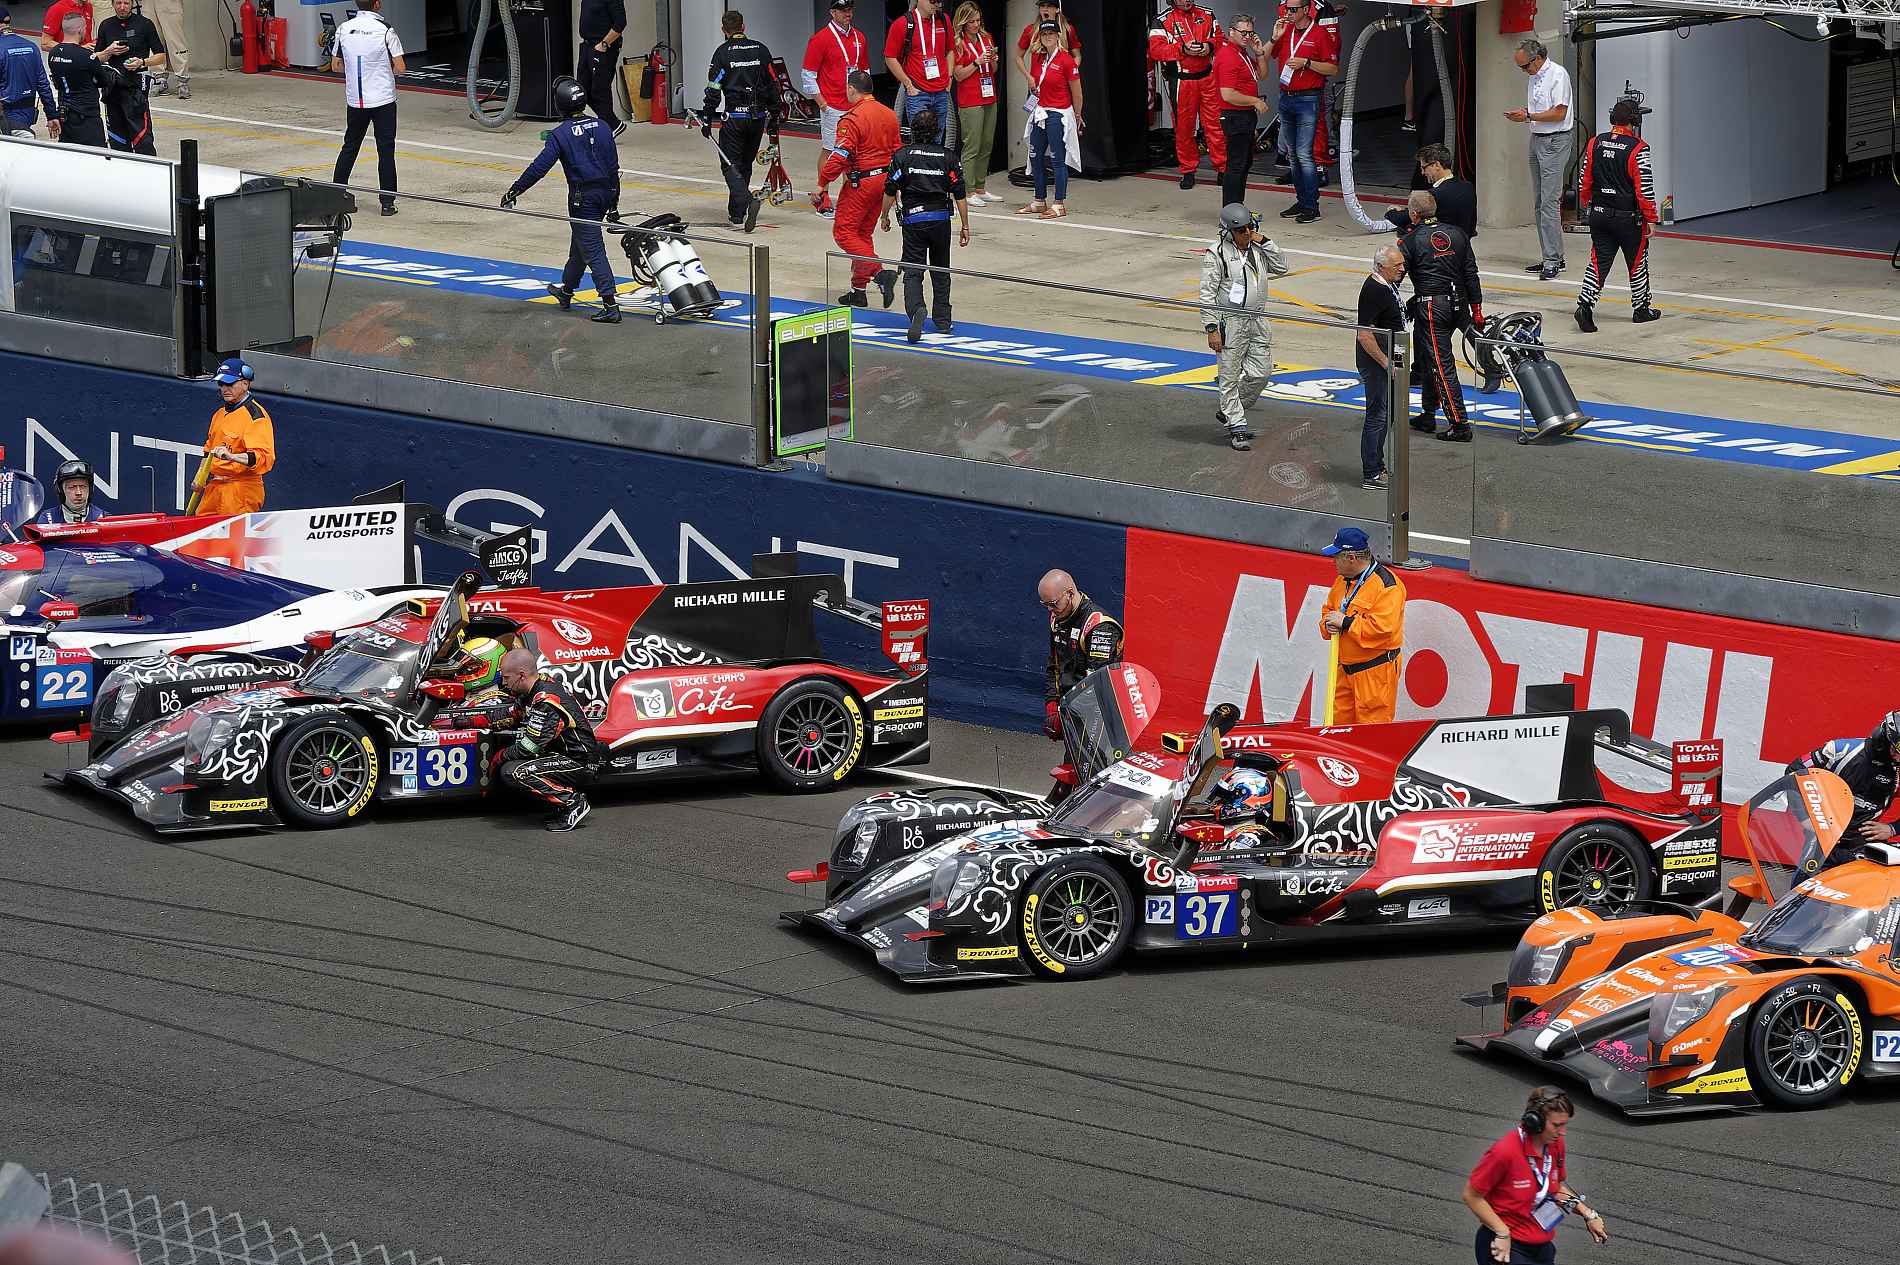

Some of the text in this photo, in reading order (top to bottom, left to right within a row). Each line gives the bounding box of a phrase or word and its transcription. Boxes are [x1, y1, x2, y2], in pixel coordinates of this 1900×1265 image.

[730, 58, 761, 68] Panasonic
[908, 167, 944, 176] Panasonic
[781, 318, 847, 340] eurasia
[309, 510, 397, 530] UNITED
[306, 526, 394, 541] AUTOSPORTS
[497, 570, 529, 585] Jetfly
[674, 590, 786, 608] RICHARD MILLE
[886, 604, 926, 612] TOTAL
[13, 637, 33, 656] P2
[42, 670, 88, 702] 22
[191, 684, 226, 694] RICHARD
[674, 675, 709, 688] JACKIE
[678, 685, 754, 715] Café
[1203, 574, 1789, 812] MOTUL
[882, 708, 922, 718] DUNLOP
[885, 721, 923, 733] sagcom
[1441, 725, 1561, 744] RICHARD MILLE
[442, 732, 476, 741] TOTAL
[841, 710, 863, 775] DUNLOP
[1220, 735, 1272, 750] OTAL
[1677, 744, 1719, 753] TOTAL
[393, 751, 415, 771] P2
[425, 747, 469, 787] 38
[130, 779, 156, 800] TOTAL
[354, 751, 378, 813] DUNLOP
[218, 800, 266, 811] DUNLOP
[935, 821, 971, 831] RICHARD
[1460, 831, 1536, 846] SEPANG
[1457, 842, 1531, 854] INTERNATIONAL
[1455, 850, 1529, 862] CIRCUIT
[1673, 856, 1715, 866] DUNLOP
[1201, 879, 1236, 888] TOTAL
[1674, 869, 1716, 883] sagcom
[1147, 900, 1172, 920] P2
[1185, 894, 1231, 937] 37
[871, 926, 893, 946] TOTAL
[1025, 901, 1050, 964] DUNLOP
[969, 948, 1017, 957] DUNLOP
[1679, 950, 1731, 966] 40
[1760, 1014, 1772, 1027] 40
[1772, 993, 1787, 1009] SET
[1847, 1007, 1862, 1080] DUNLOP
[1875, 1034, 1900, 1058] P2
[1709, 1075, 1747, 1087] DUNLOP
